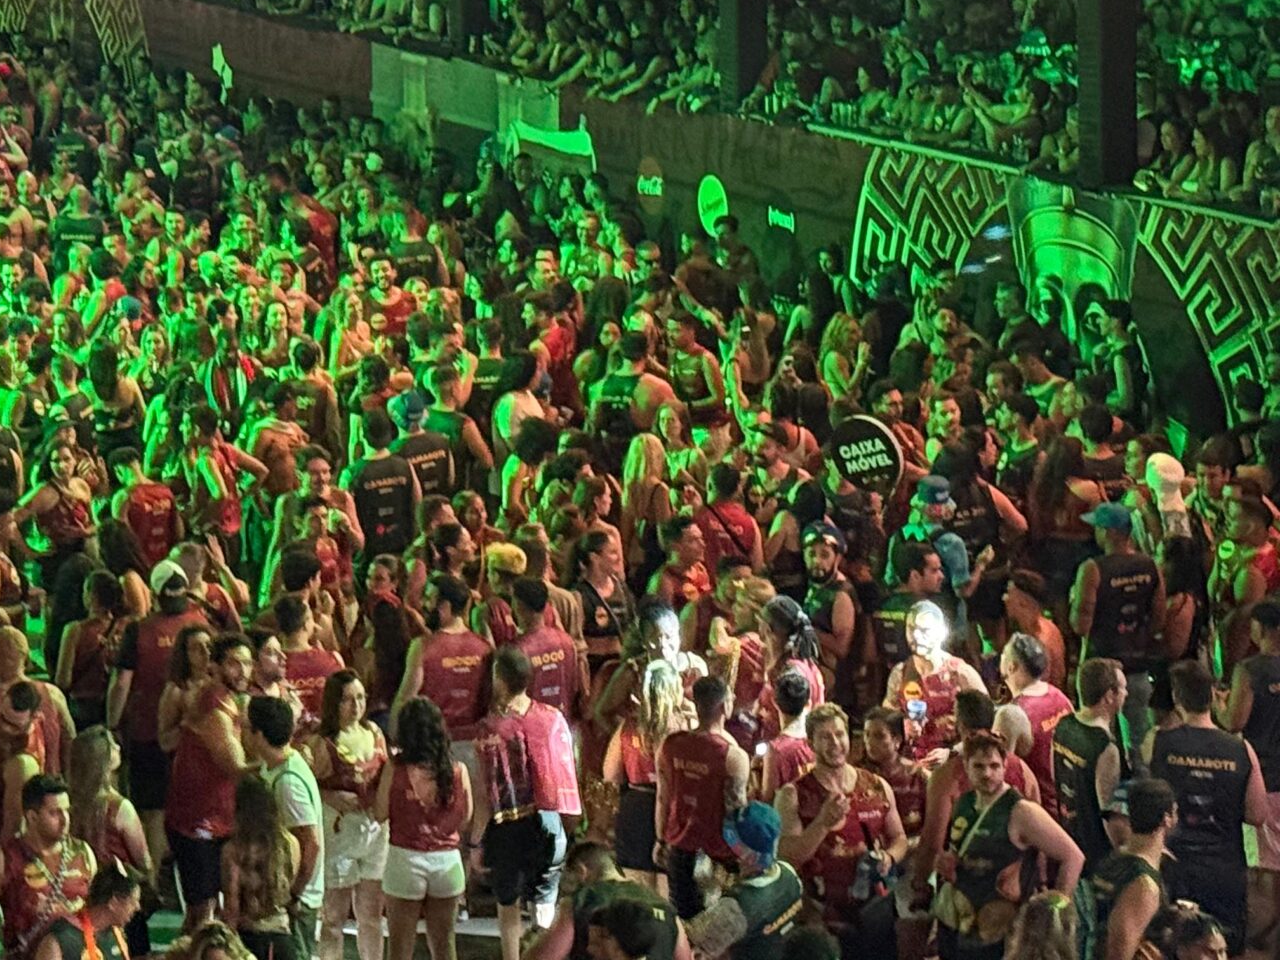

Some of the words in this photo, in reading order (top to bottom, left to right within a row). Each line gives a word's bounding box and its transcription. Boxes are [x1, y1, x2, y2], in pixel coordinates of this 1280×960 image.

[839, 438, 887, 460] CAIXA
[845, 453, 894, 475] MÓVEL
[1167, 754, 1237, 772] CAMAROTE
